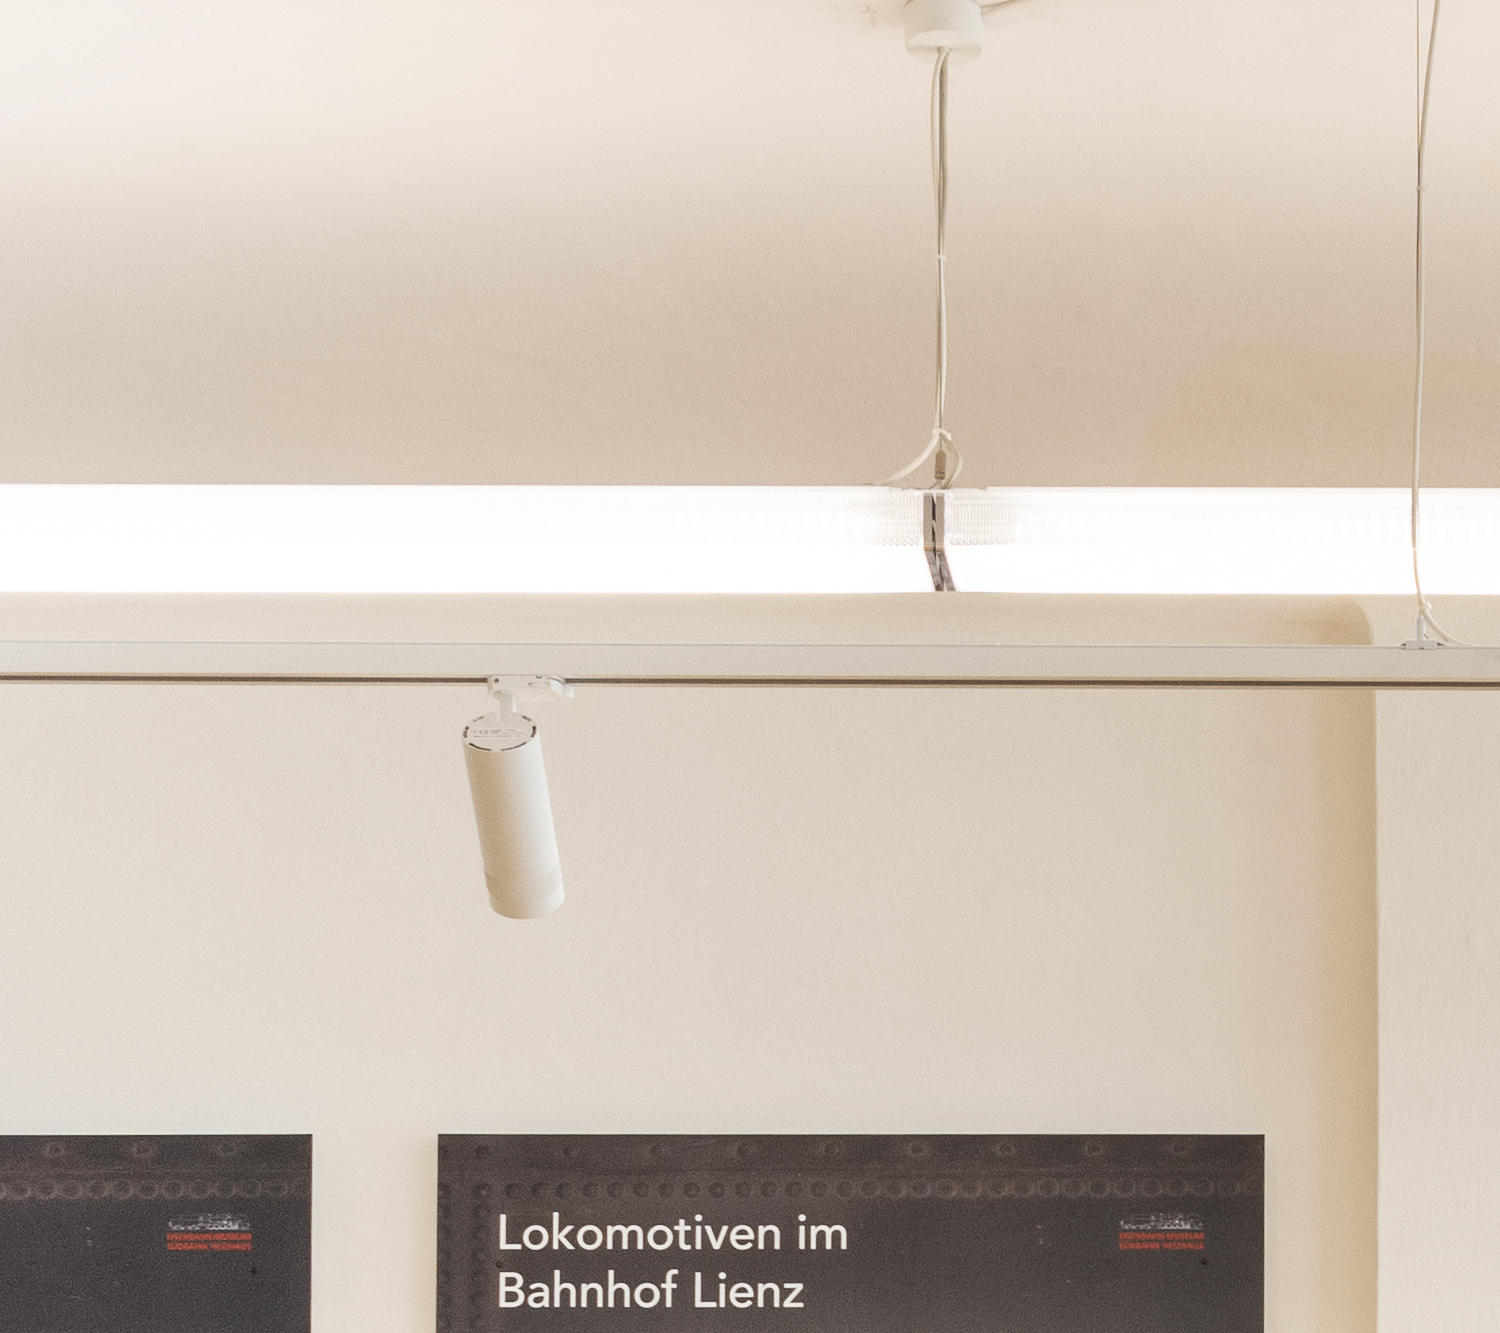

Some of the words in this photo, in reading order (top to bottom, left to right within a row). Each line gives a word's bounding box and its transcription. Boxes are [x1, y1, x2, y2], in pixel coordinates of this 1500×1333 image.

[500, 1212, 780, 1250] Lokomotiven
[798, 1214, 847, 1249] im
[499, 1269, 678, 1308] Bahnhof
[695, 1272, 804, 1308] Lienz
